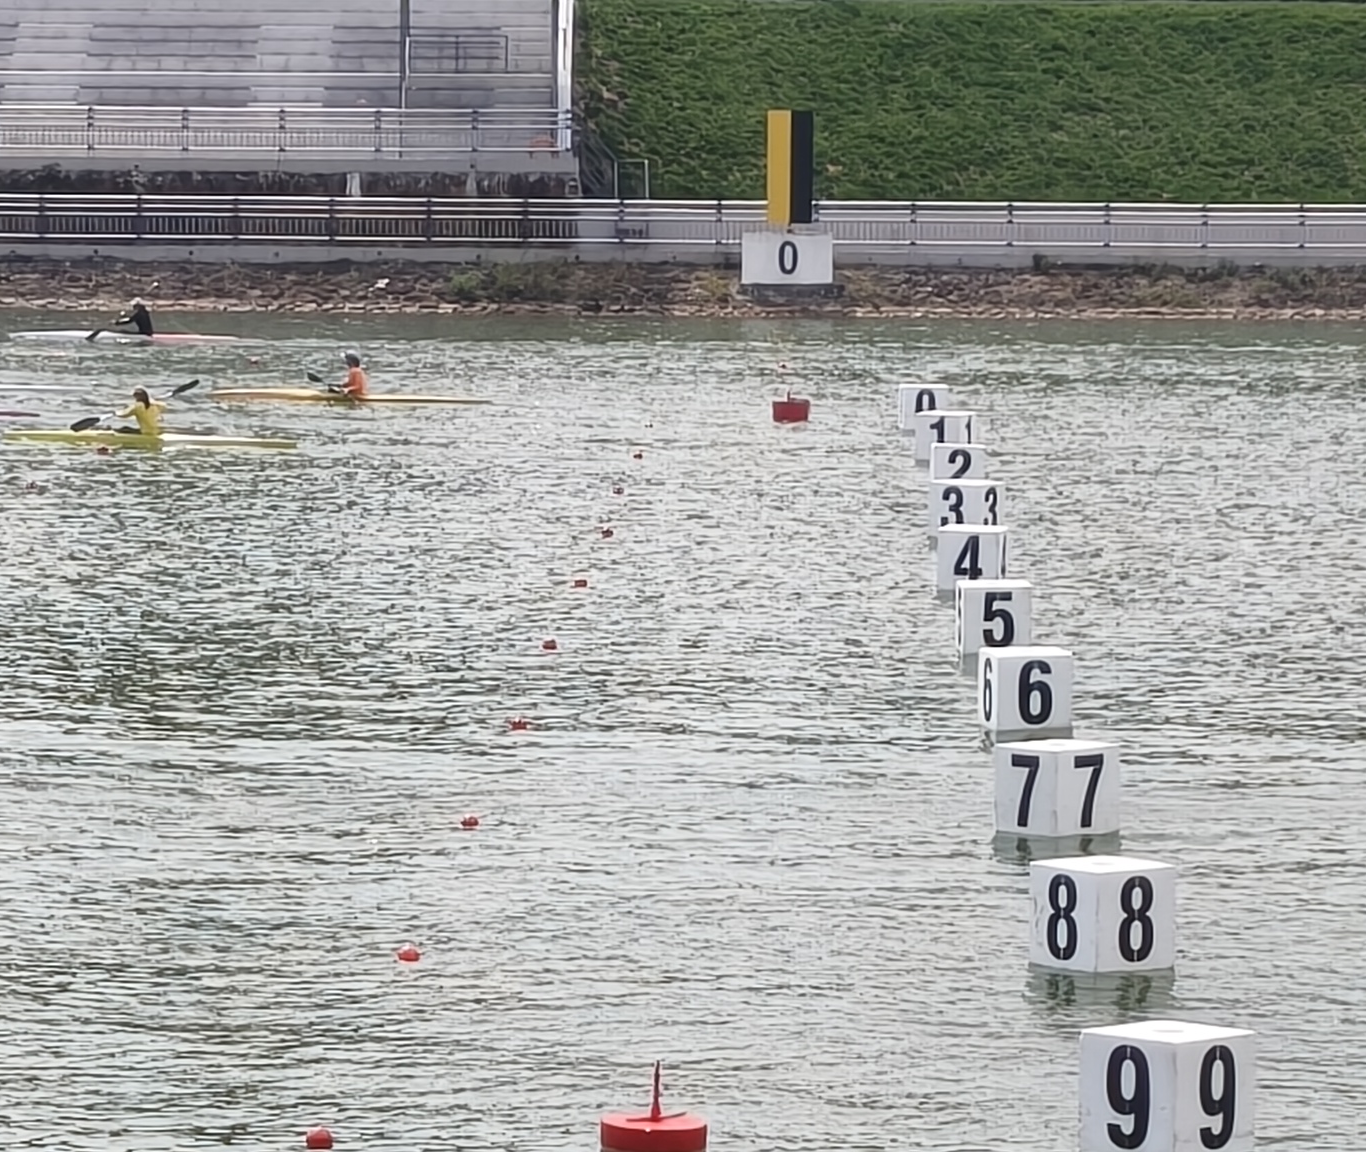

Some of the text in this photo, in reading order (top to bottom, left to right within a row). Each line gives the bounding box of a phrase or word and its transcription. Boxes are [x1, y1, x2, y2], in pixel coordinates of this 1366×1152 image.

[778, 240, 799, 275] 0
[947, 449, 972, 479] 2
[940, 486, 964, 526] 3
[983, 487, 998, 526] 3
[954, 535, 983, 580] 4
[982, 591, 1015, 647] 5
[983, 657, 993, 722] 6
[1018, 660, 1053, 725] 6
[1010, 754, 1039, 828] 7
[1073, 753, 1104, 828] 7
[1046, 874, 1078, 961] 8
[1118, 875, 1154, 963] 8
[1105, 1044, 1150, 1150] 9
[1199, 1044, 1236, 1150] 9
